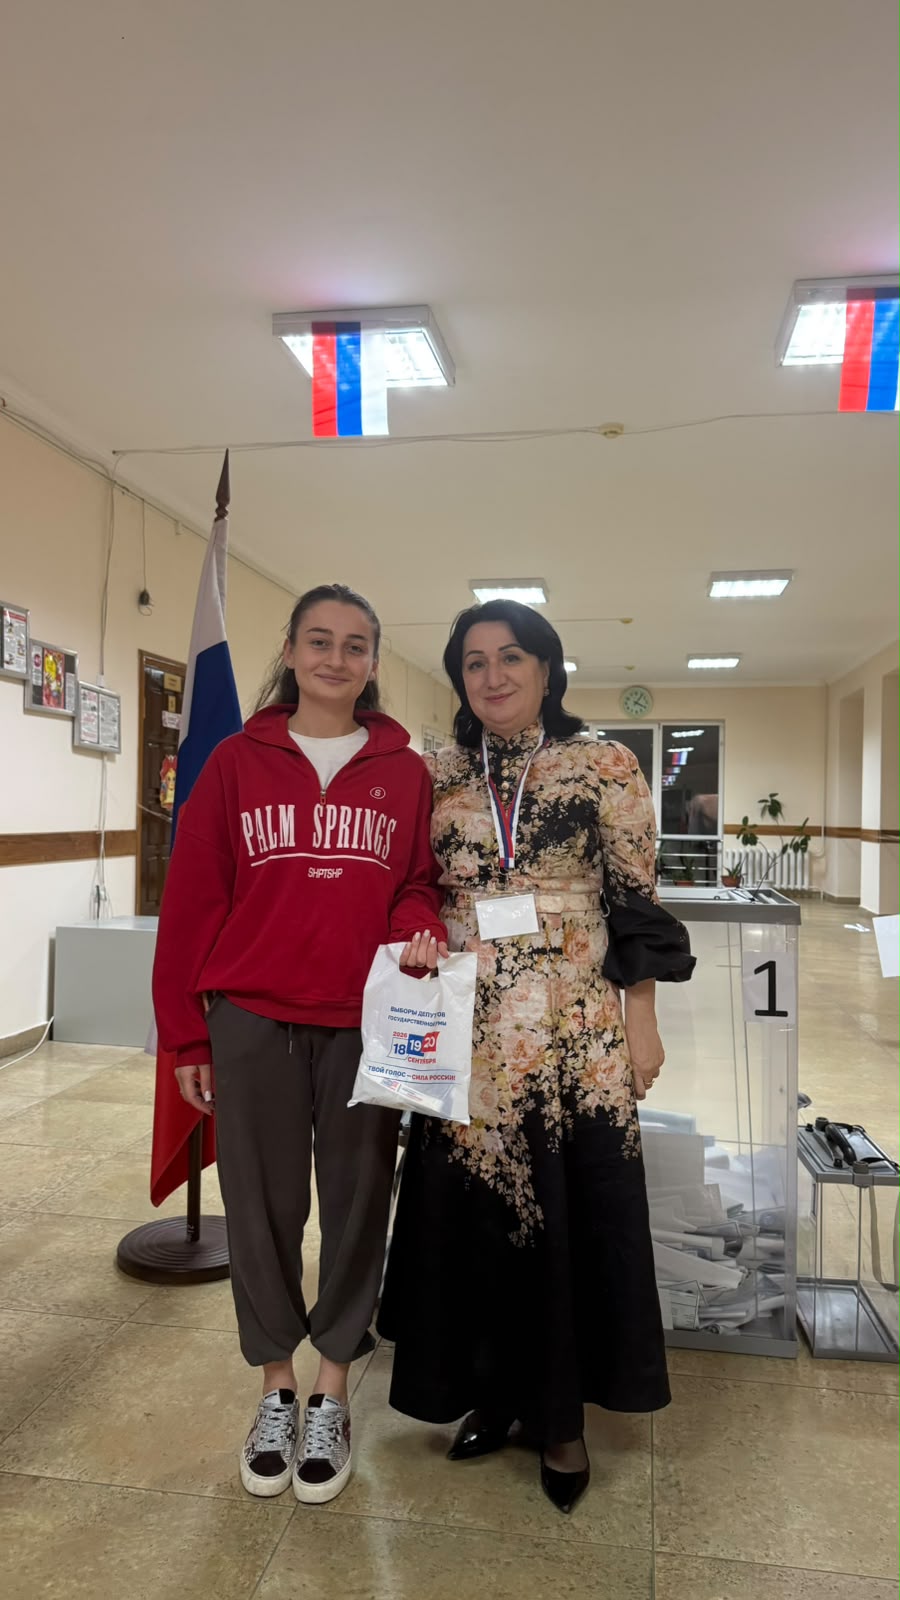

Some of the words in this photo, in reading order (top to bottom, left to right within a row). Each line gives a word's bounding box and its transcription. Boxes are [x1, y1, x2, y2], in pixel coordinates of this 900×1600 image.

[240, 804, 296, 857] PALM
[312, 803, 397, 860] SPRINGS
[308, 867, 343, 879] SHPTSHP
[753, 960, 789, 1018] 1
[390, 1006, 417, 1015] ВЫБОРЫ
[393, 1043, 406, 1055] 18
[409, 1039, 422, 1052] 19
[423, 1037, 436, 1048] 20
[368, 1065, 385, 1074] ТВОЙ
[385, 1068, 406, 1078] ГОЛОС
